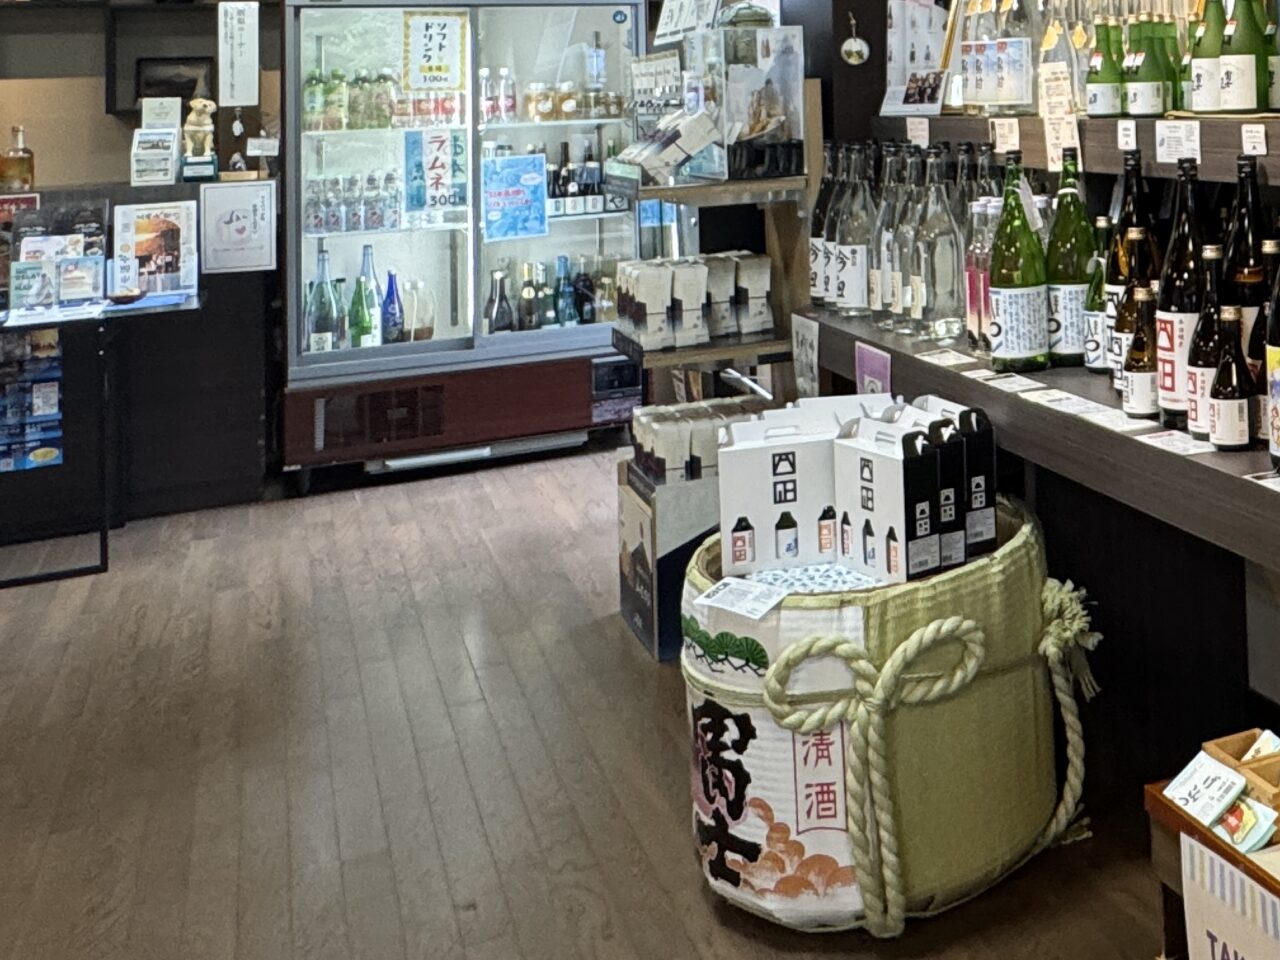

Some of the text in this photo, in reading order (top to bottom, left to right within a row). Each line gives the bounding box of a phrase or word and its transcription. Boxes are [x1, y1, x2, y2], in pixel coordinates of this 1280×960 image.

[422, 22, 433, 64] ドリンク
[436, 22, 447, 52] ソフト
[428, 134, 447, 191] ラムネ
[802, 729, 837, 820] 清酒
